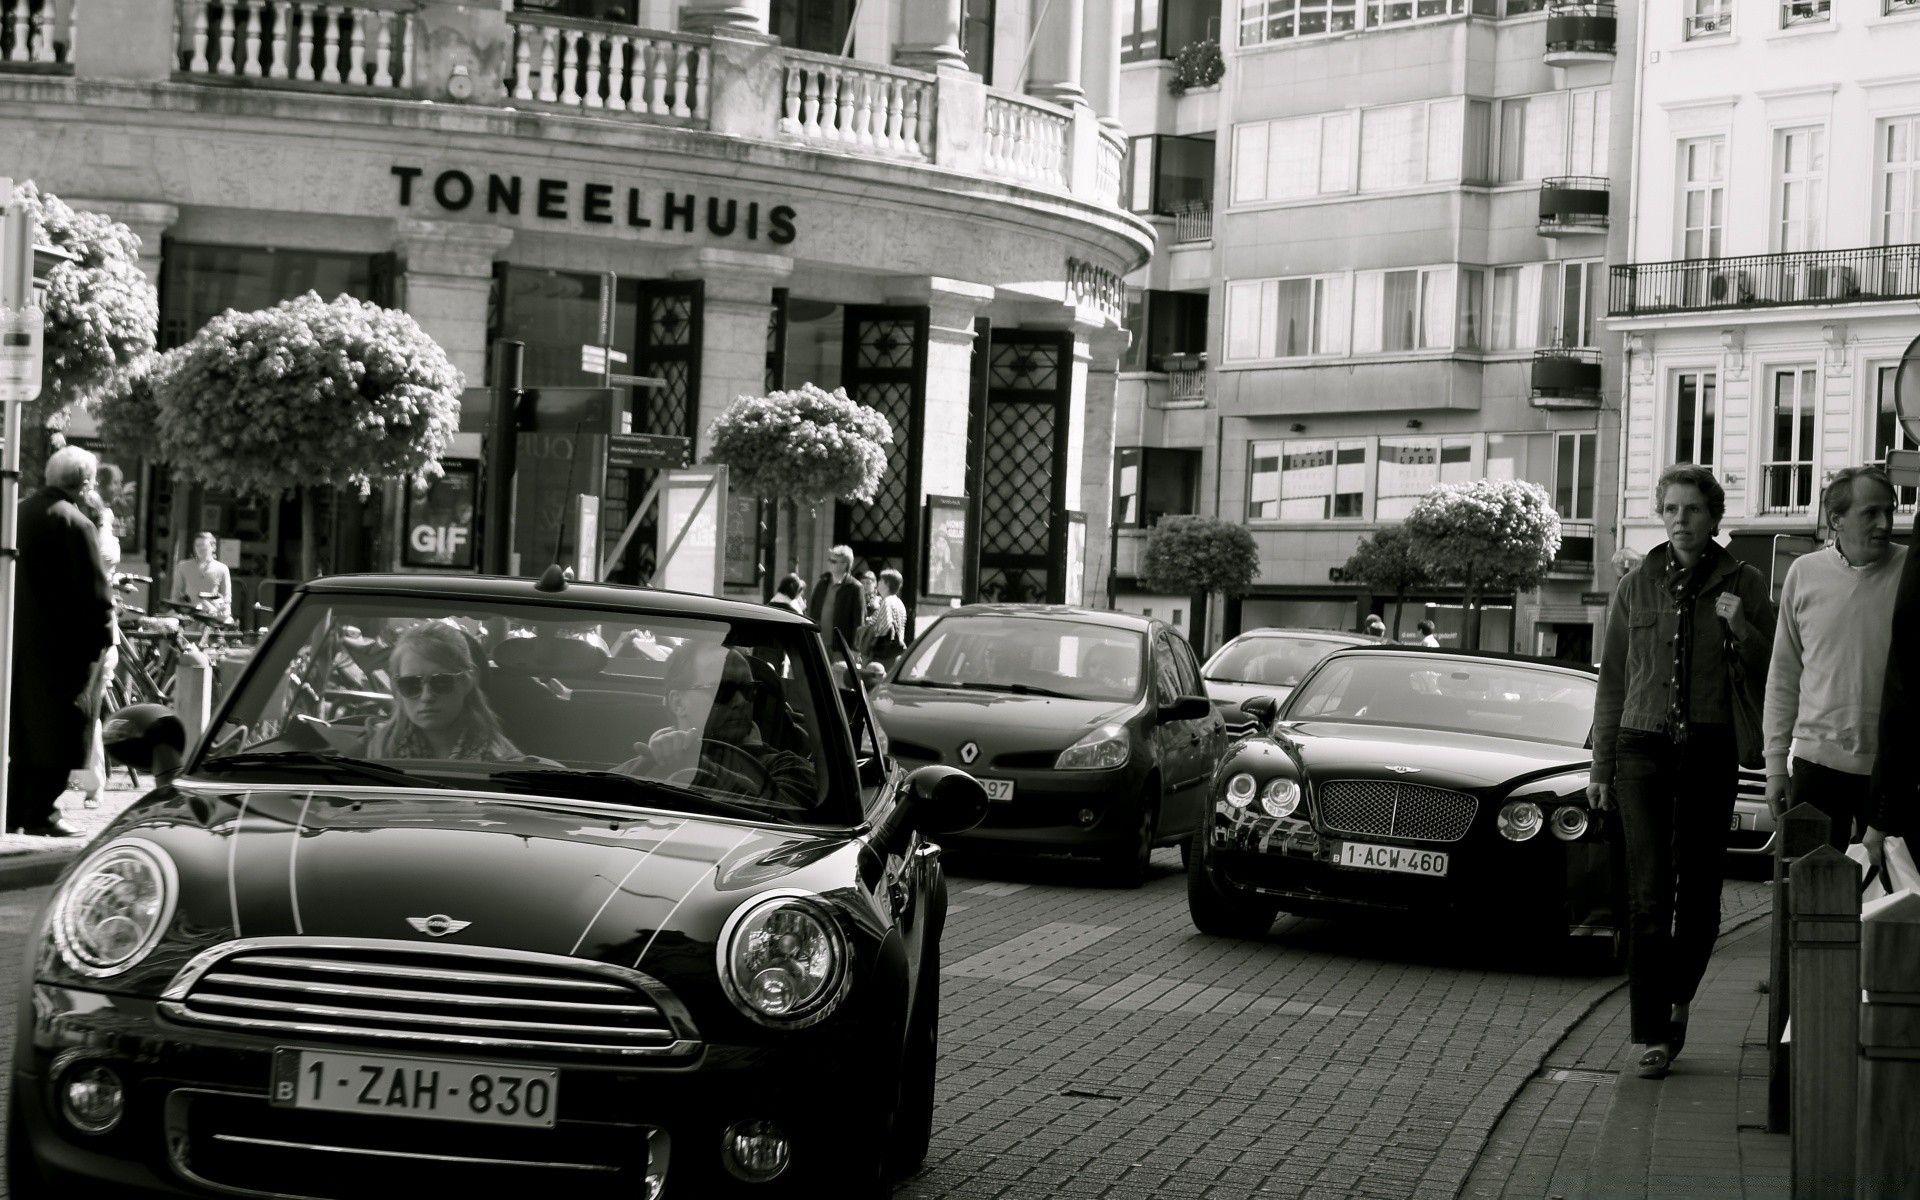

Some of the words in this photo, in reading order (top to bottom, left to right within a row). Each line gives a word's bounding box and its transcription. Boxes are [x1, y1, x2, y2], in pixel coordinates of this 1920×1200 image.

[391, 166, 797, 245] TONEELHUIS
[410, 523, 469, 554] GIF
[979, 780, 1010, 798] 97
[276, 1081, 295, 1100] B
[307, 1060, 550, 1119] 1-ZAH-830
